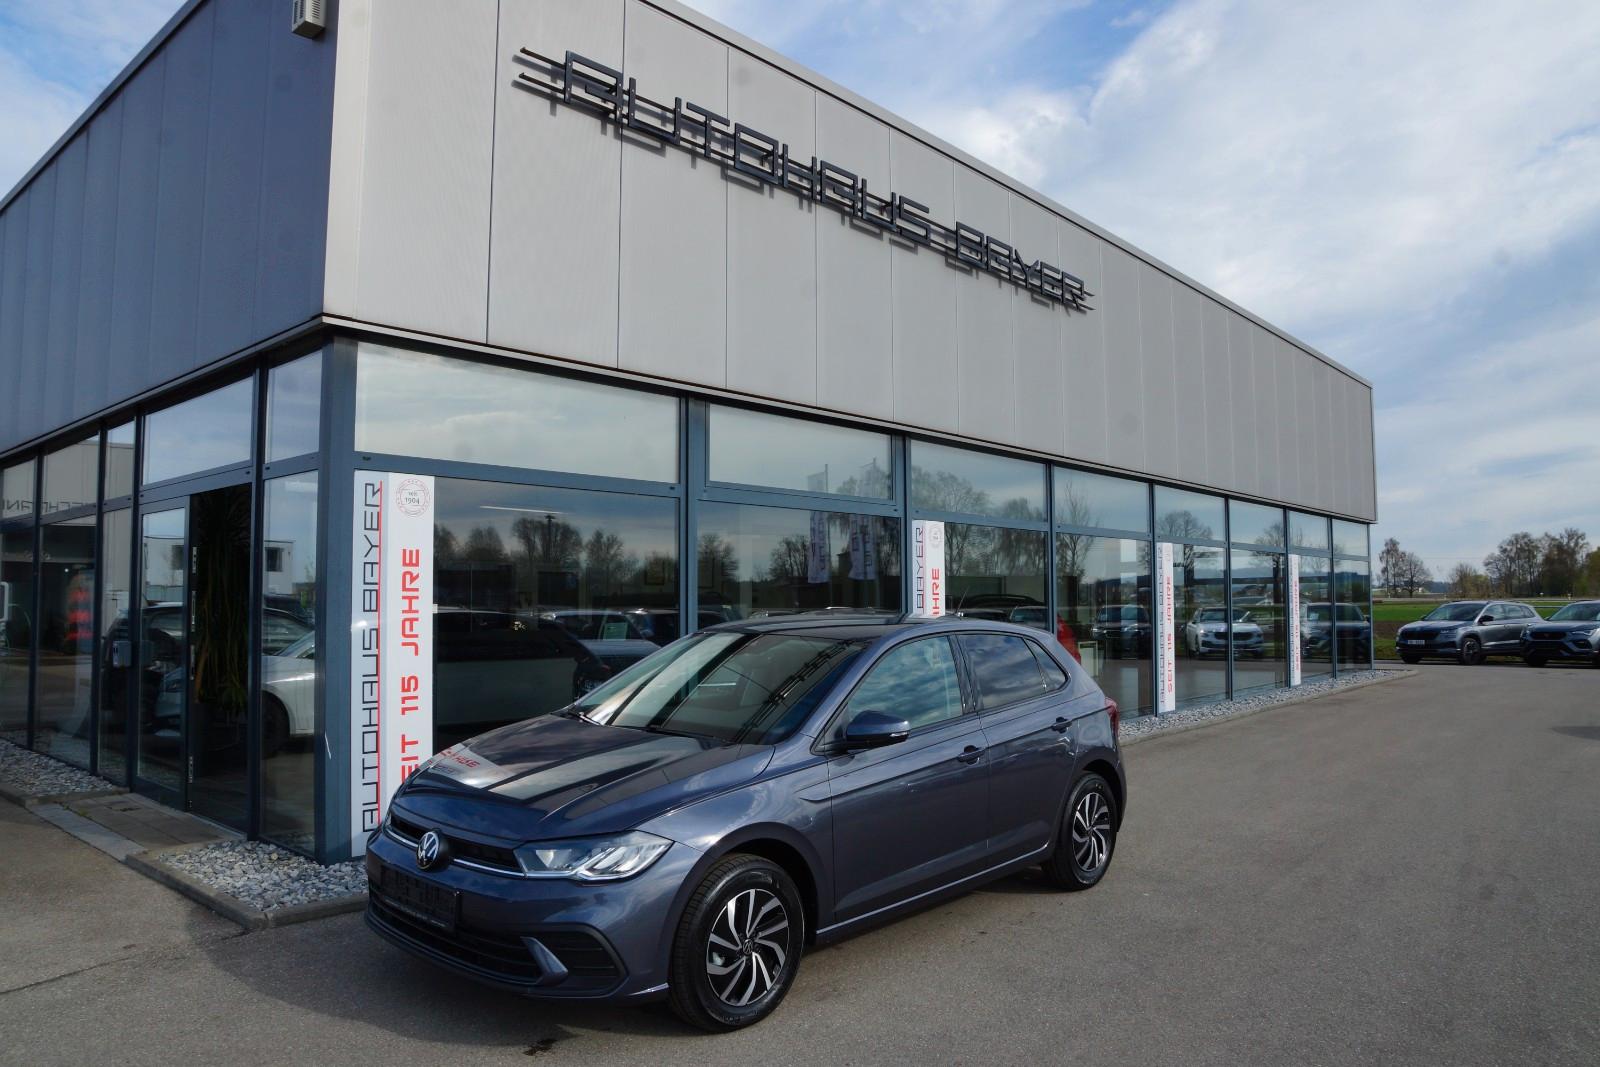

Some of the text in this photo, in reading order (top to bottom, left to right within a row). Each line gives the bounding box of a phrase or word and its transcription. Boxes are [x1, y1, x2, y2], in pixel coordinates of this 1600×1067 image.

[564, 50, 1086, 311] AUTOHAUS BAYER
[362, 482, 381, 832] AUTOHAUS BAYER
[400, 548, 420, 656] JAHRE
[400, 675, 419, 715] 115
